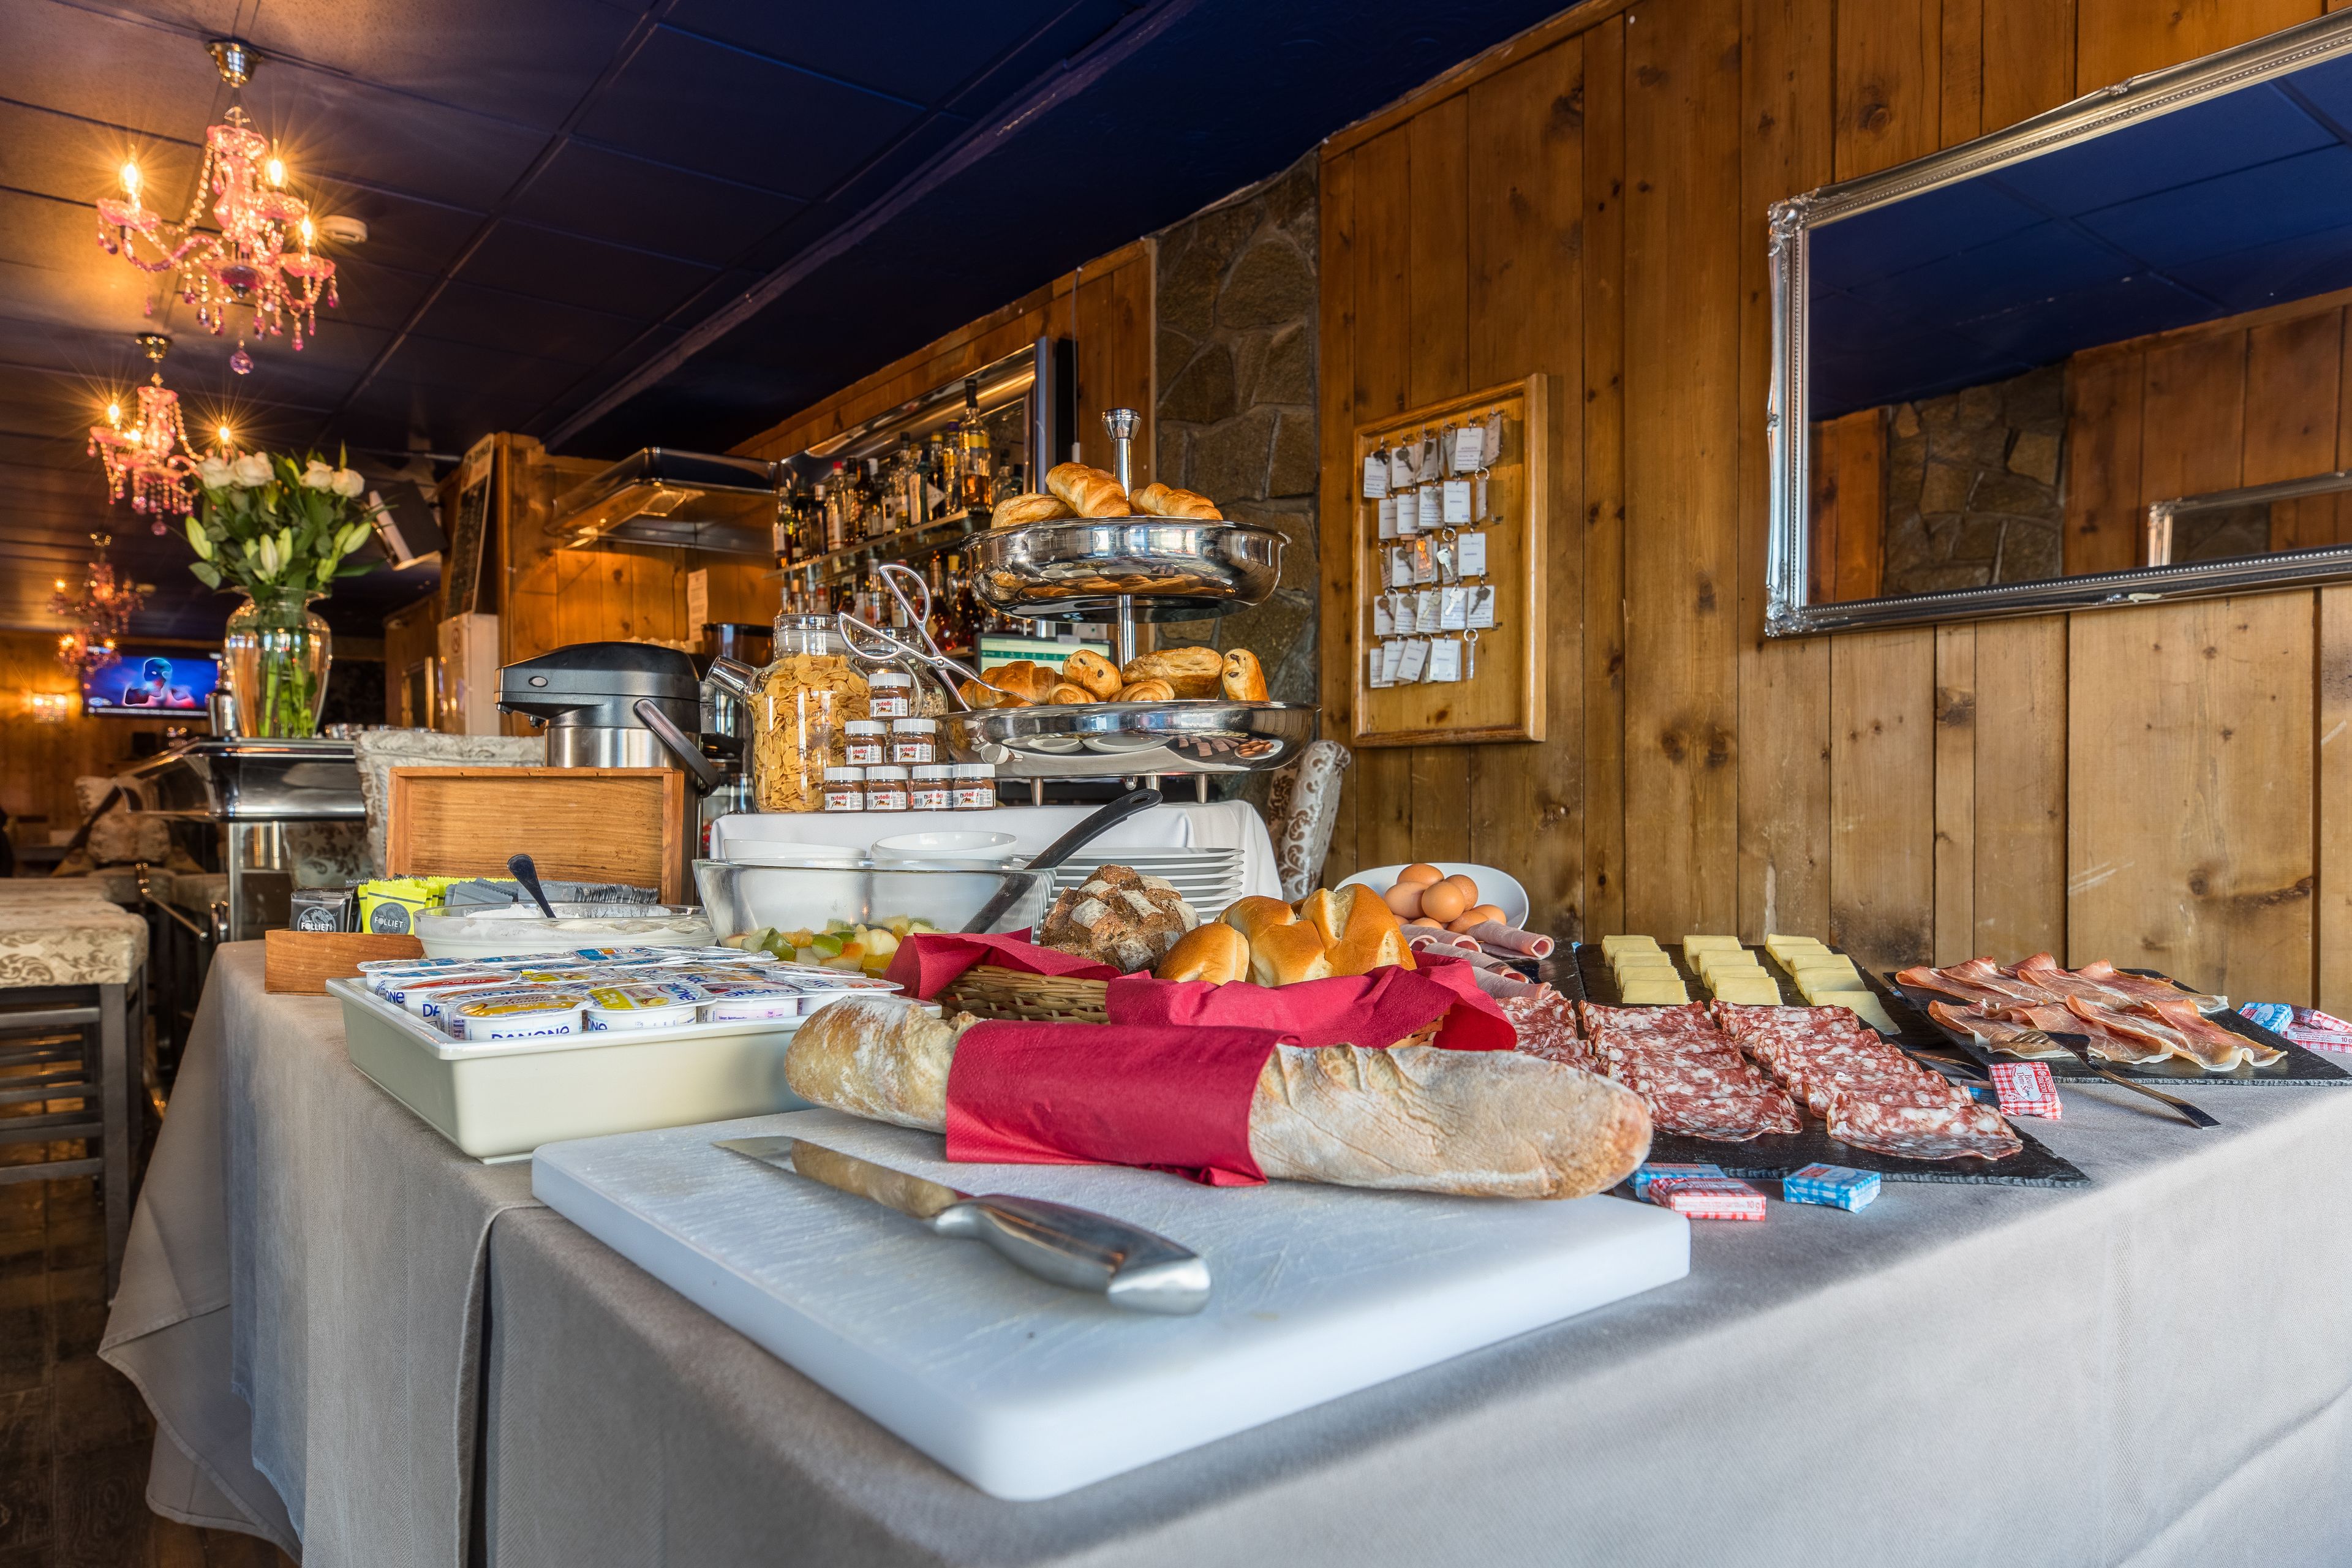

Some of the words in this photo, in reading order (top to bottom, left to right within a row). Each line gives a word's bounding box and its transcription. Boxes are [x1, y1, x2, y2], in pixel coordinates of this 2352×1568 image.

[301, 922, 330, 931] FOLLIET
[374, 916, 403, 929] FOLLIET
[2024, 1074, 2034, 1090] Beurre
